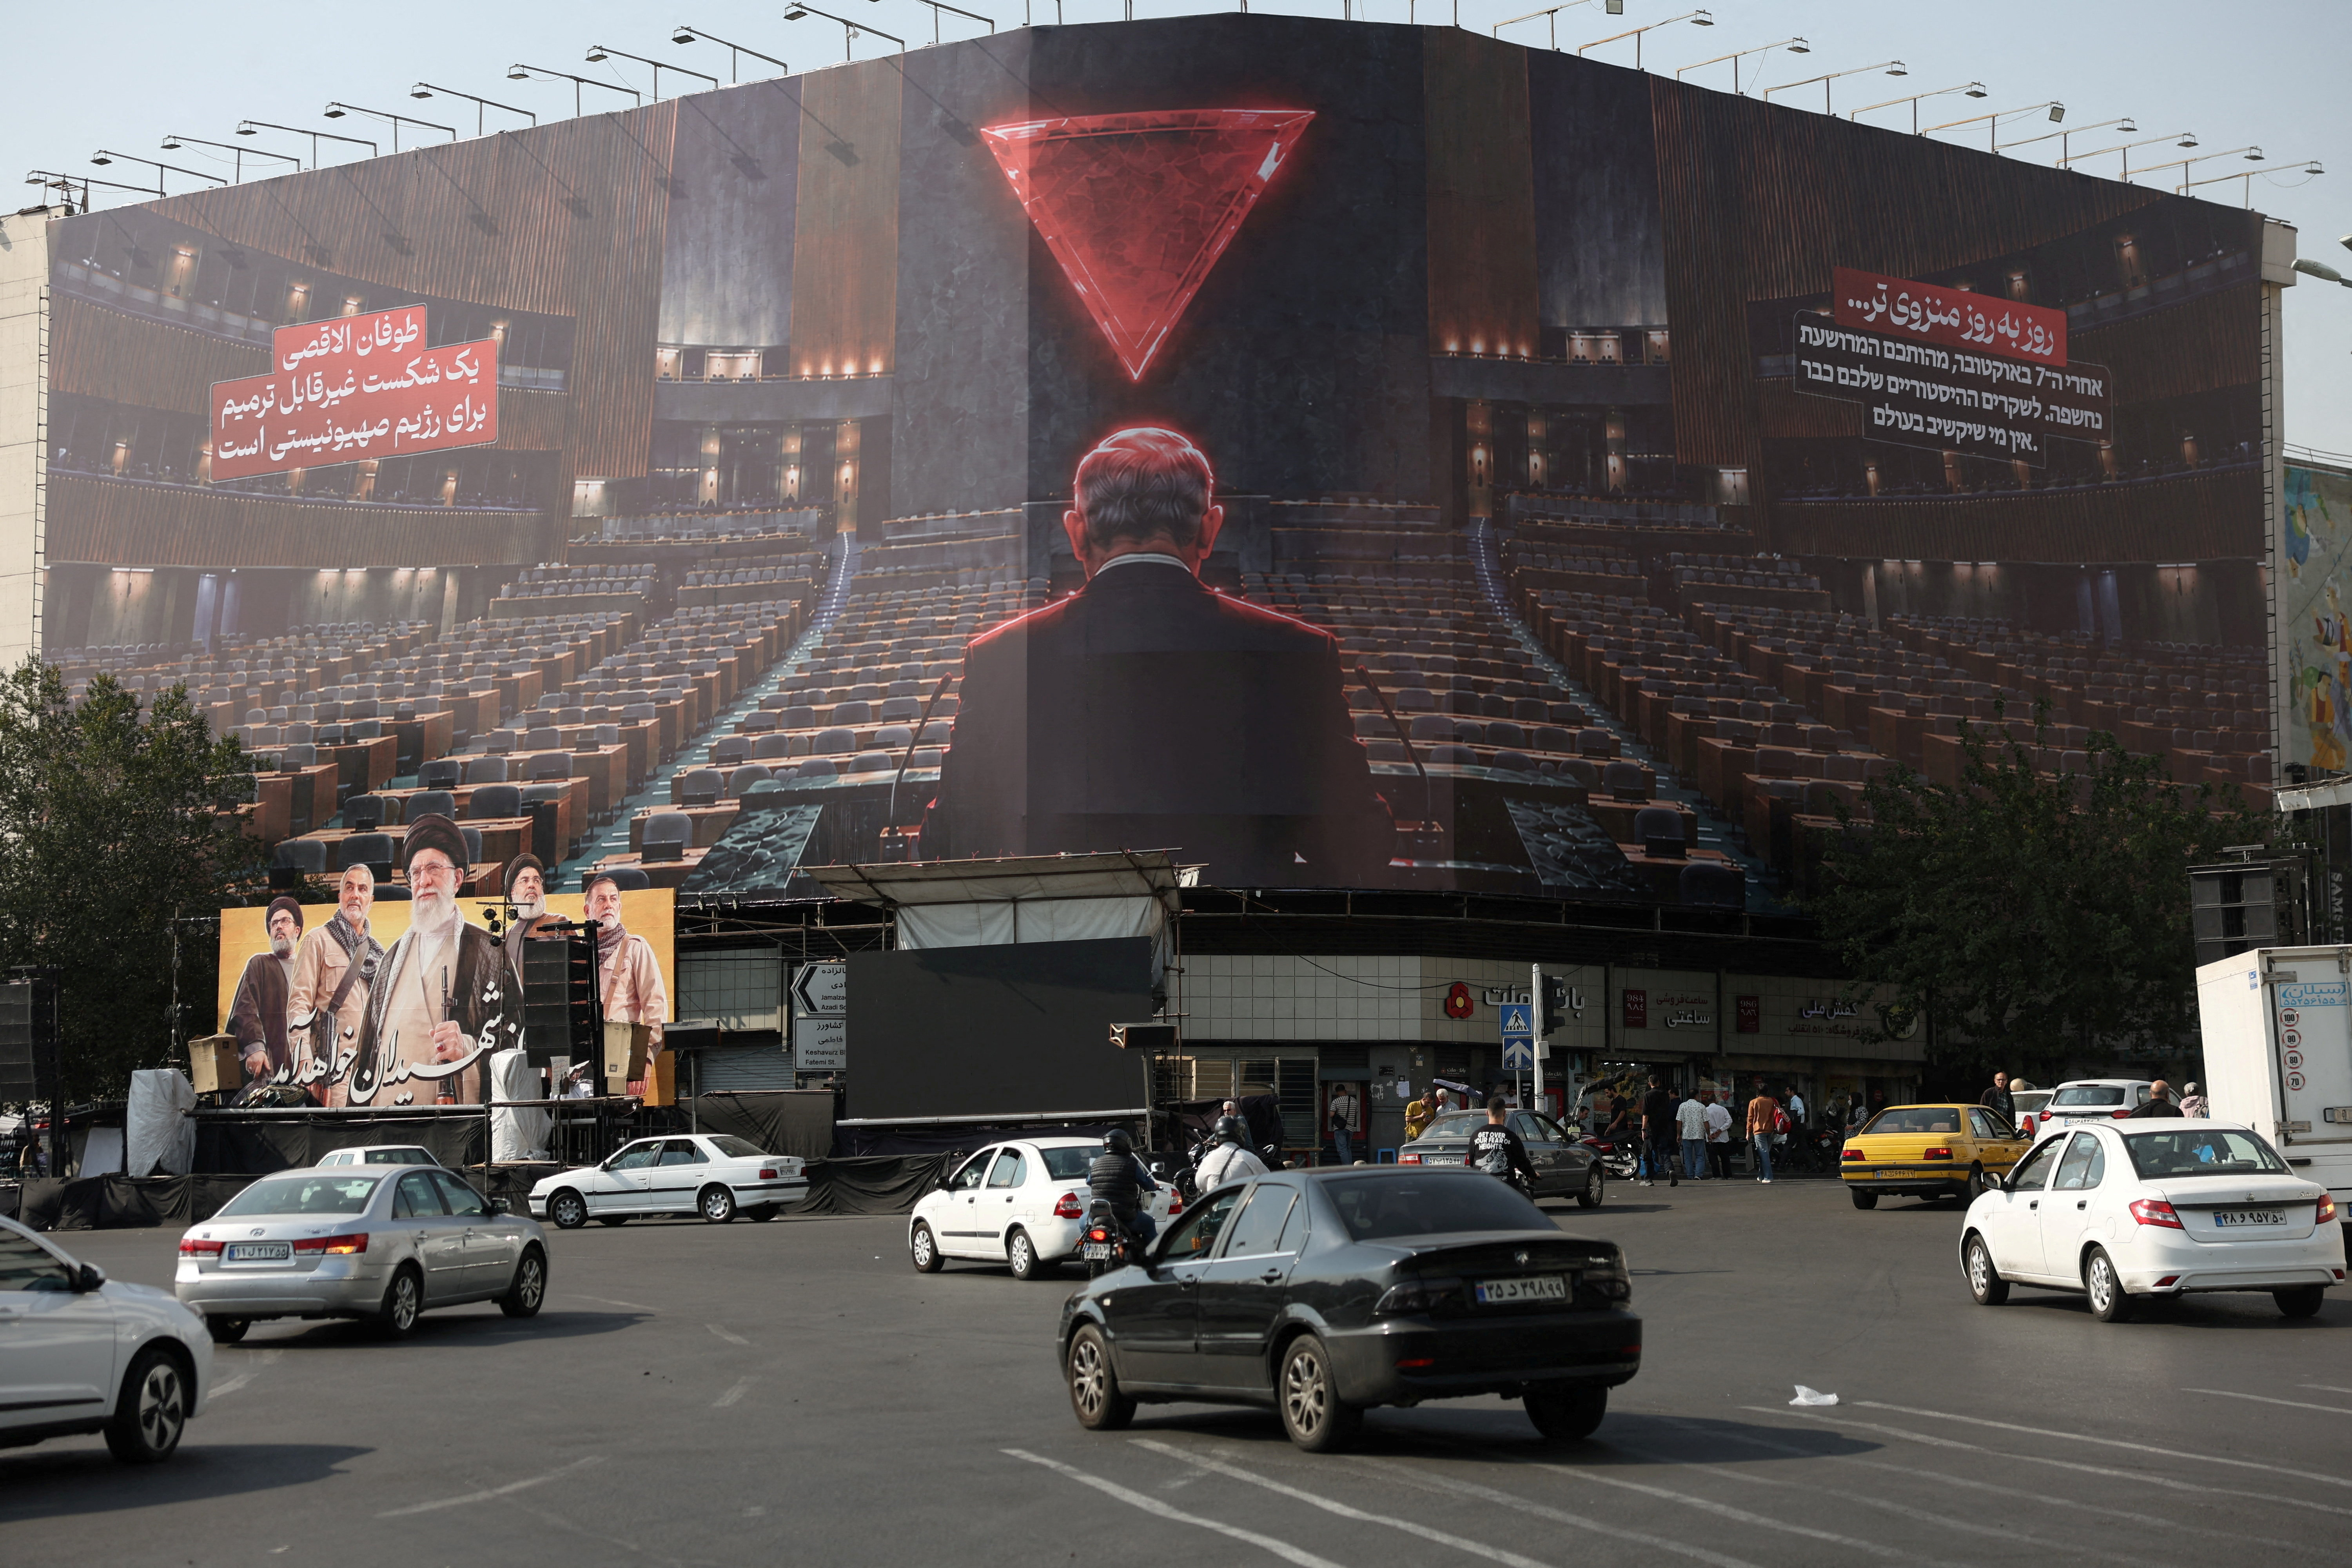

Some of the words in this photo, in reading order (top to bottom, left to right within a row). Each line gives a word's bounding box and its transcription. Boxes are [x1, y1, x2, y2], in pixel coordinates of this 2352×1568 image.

[1890, 291, 1960, 333] منزوی
[1960, 304, 1995, 345] روز
[356, 314, 419, 357] طوفان
[1800, 324, 1880, 356] המרושעת
[1998, 310, 2019, 348] به
[2020, 316, 2053, 356] روز
[282, 323, 351, 371] الاقصی
[1883, 340, 1949, 369] מהותכם
[363, 356, 440, 393] شکست
[445, 348, 479, 384] یک
[1801, 360, 1834, 383] כבר
[1837, 364, 1884, 390] שלכם
[1951, 354, 2032, 385] באוקטובר,
[1887, 375, 1978, 408] ההיסטוריים
[2065, 377, 2103, 397] אחרי
[221, 384, 276, 429] ترمیم
[446, 394, 487, 433] برای
[1873, 403, 1925, 431] בעולם
[1982, 390, 2042, 420] לשקרים
[2045, 403, 2102, 430] נחשפה.
[269, 416, 389, 461] صهیونیستی
[394, 404, 441, 448] رژیم
[1926, 416, 1987, 444] שיקשיב
[1989, 428, 2006, 446] מי
[218, 425, 264, 459] است
[1484, 984, 1532, 1006] ملت
[1627, 994, 1644, 1002] 984
[1802, 1000, 1825, 1019] ملی
[1826, 999, 1858, 1020] کفش
[817, 1022, 843, 1031] کشاورز
[1667, 1010, 1710, 1028] ساعتی
[1788, 1024, 1811, 1035] انقلاب
[2284, 1014, 2295, 1022] 100
[270, 1006, 318, 1085] آمد
[289, 1025, 358, 1085] خواهد
[818, 1036, 843, 1045] فاطمی
